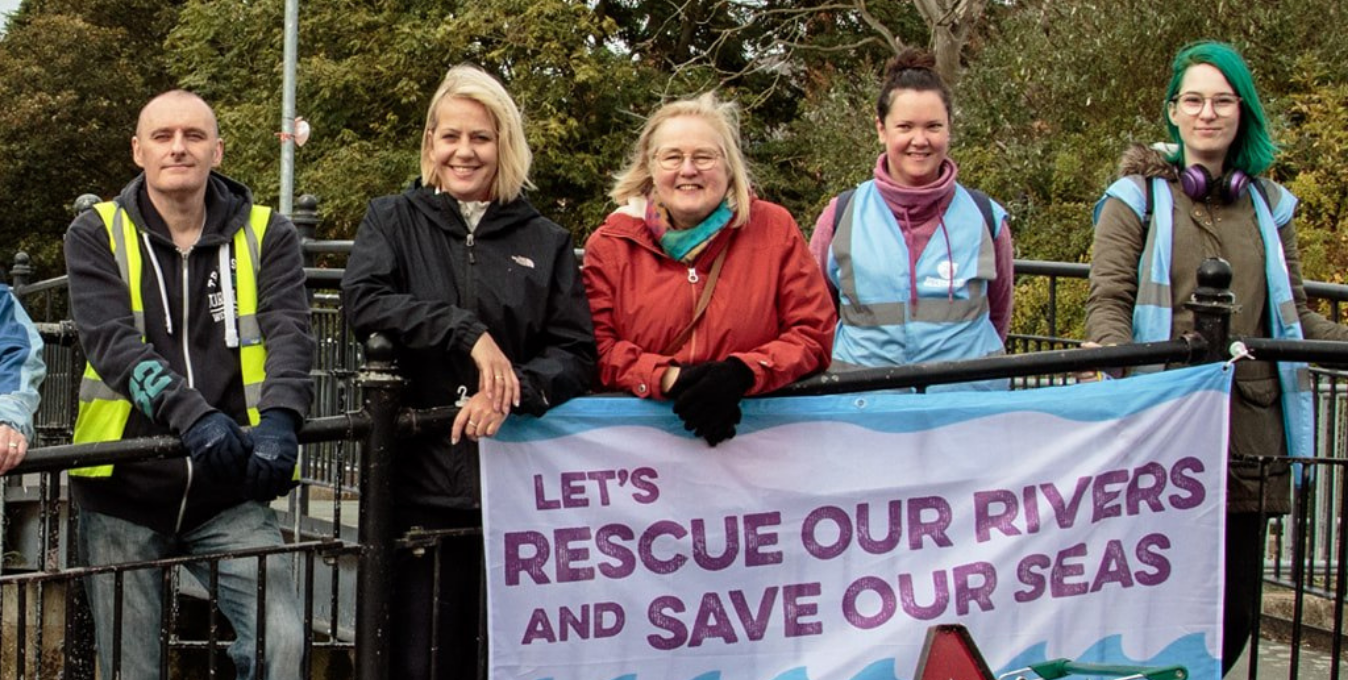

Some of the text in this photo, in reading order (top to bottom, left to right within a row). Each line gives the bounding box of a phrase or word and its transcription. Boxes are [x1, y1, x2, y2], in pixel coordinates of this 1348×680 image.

[504, 457, 1206, 586] RESCUE OUR RIVERS
[533, 466, 660, 510] LET'S
[521, 533, 1172, 650] AND SAVE OUR SEAS
